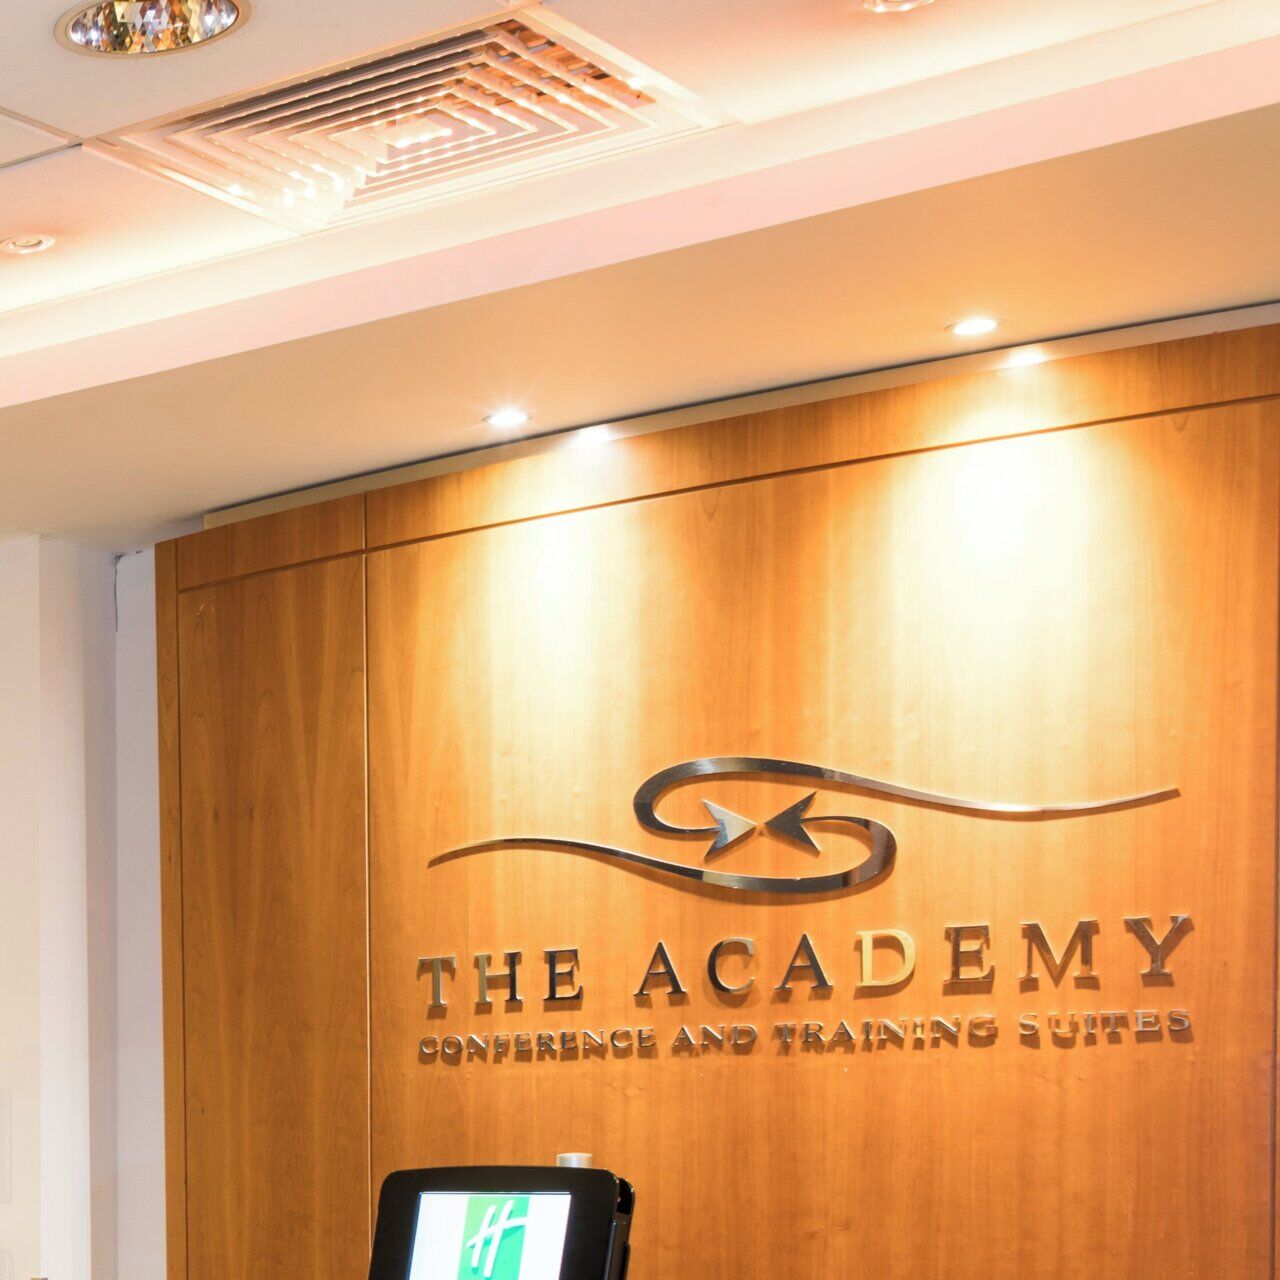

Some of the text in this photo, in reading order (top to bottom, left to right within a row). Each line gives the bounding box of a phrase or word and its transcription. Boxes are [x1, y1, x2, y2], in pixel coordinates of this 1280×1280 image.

[417, 914, 1191, 1007] THE ACADEMY
[418, 1008, 1192, 1055] CONFERENCE AND TRAINING SUITES
